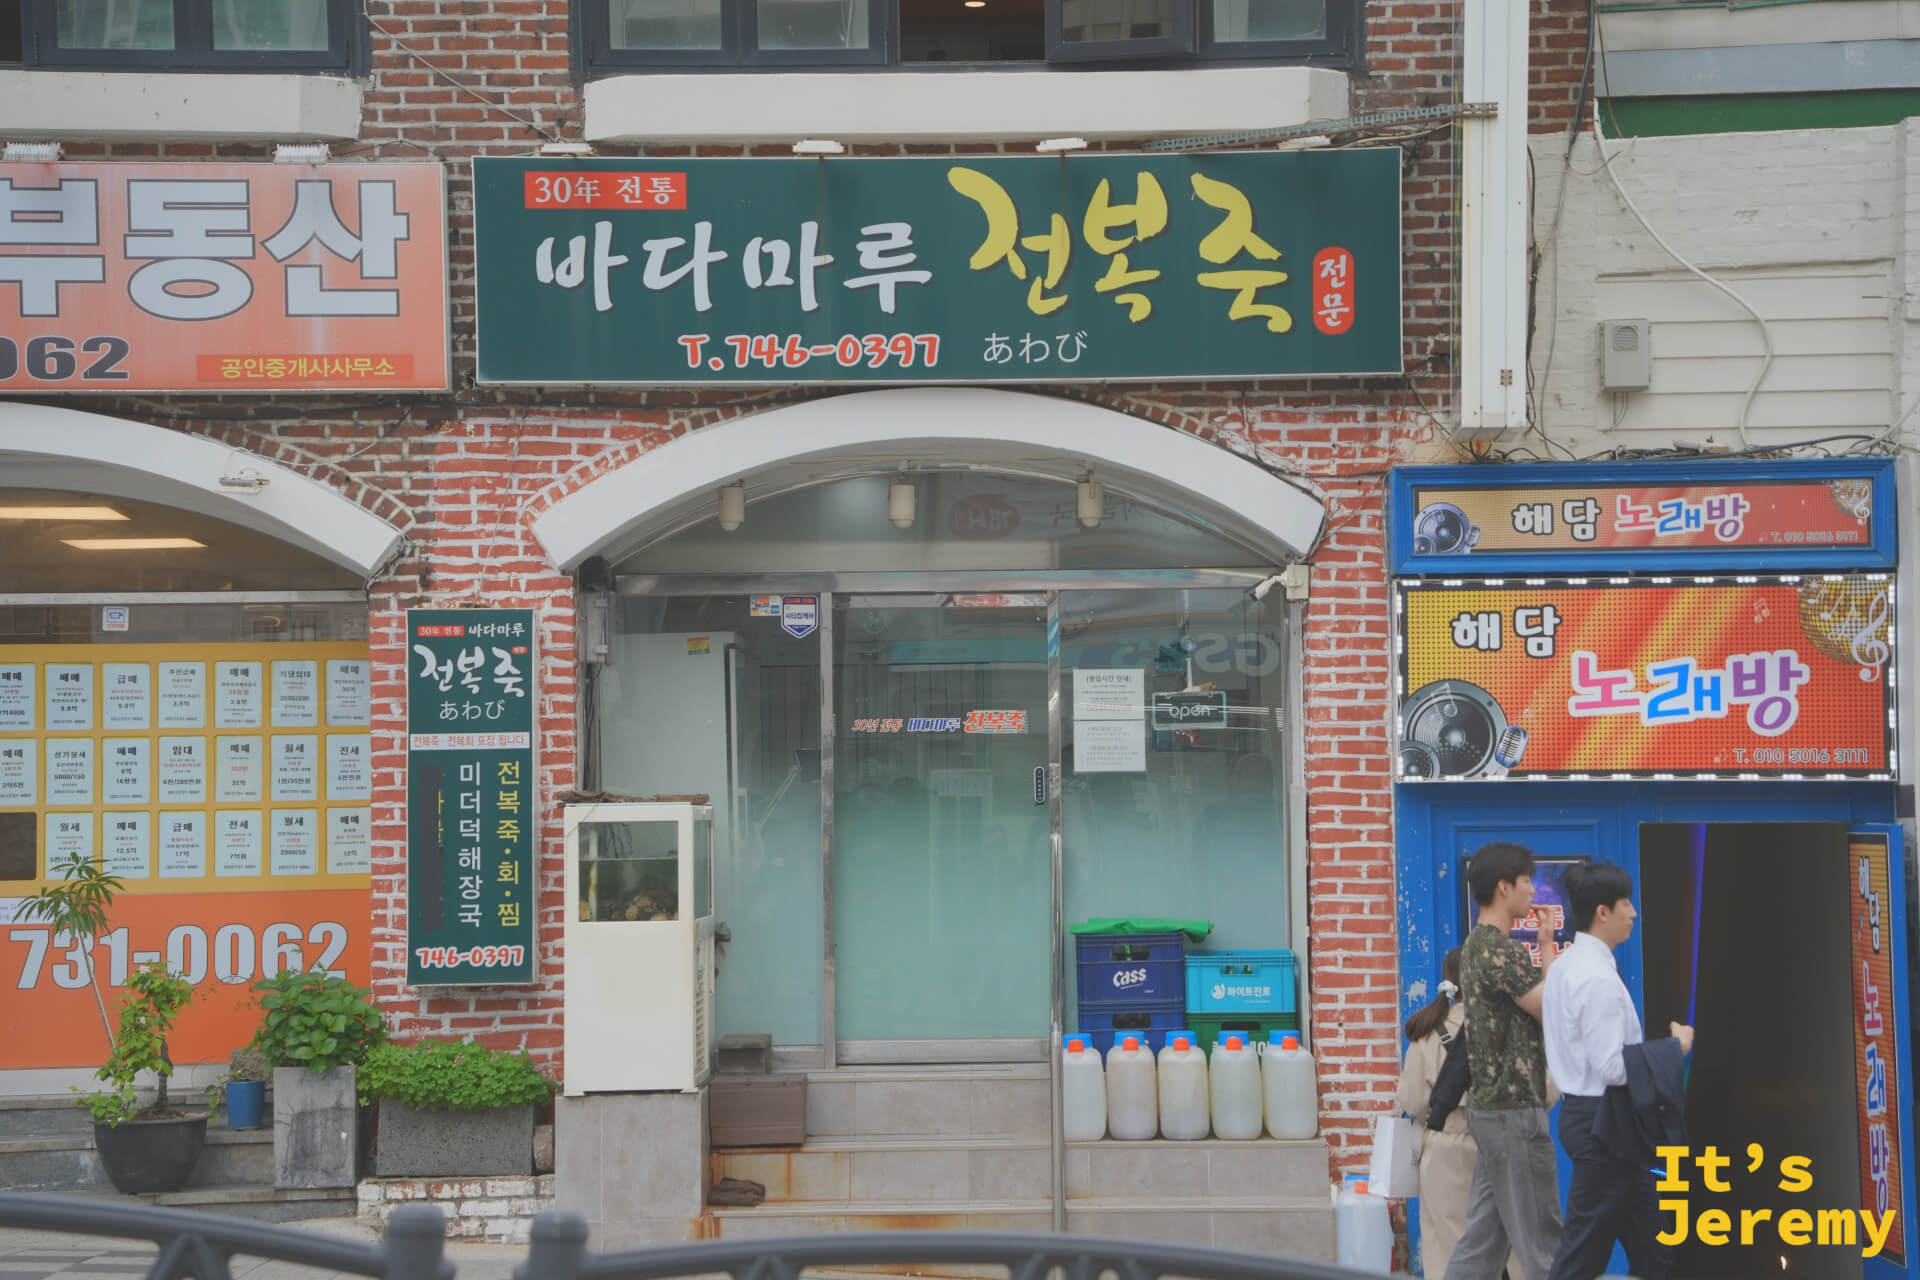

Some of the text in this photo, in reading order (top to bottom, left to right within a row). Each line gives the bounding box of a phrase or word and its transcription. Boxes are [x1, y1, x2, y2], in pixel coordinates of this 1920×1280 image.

[534, 176, 677, 205] 30年 전통
[0, 177, 409, 321] 부동산
[535, 166, 1293, 333] 바다마루 전복죽
[1314, 253, 1352, 327] 전문
[677, 332, 941, 372] T.746-0397
[983, 330, 1088, 364] あわび
[220, 356, 397, 378] 공인중개사사무소
[1614, 493, 1750, 542] 노래방
[469, 623, 525, 637] 바다마루
[413, 644, 525, 697] 전복죽
[440, 699, 504, 720] あわび
[1568, 649, 1810, 737] 노래방
[1169, 704, 1212, 720] open
[414, 735, 440, 748] 전복죽
[477, 735, 495, 747] 포장
[498, 734, 525, 746] 됩니다
[1733, 747, 1869, 763] T. 010 5016 3111
[457, 762, 483, 928] 미더덕해장국
[416, 945, 525, 968] 746-0397
[1112, 968, 1148, 988] Cass
[1863, 960, 1890, 1220] 노래방
